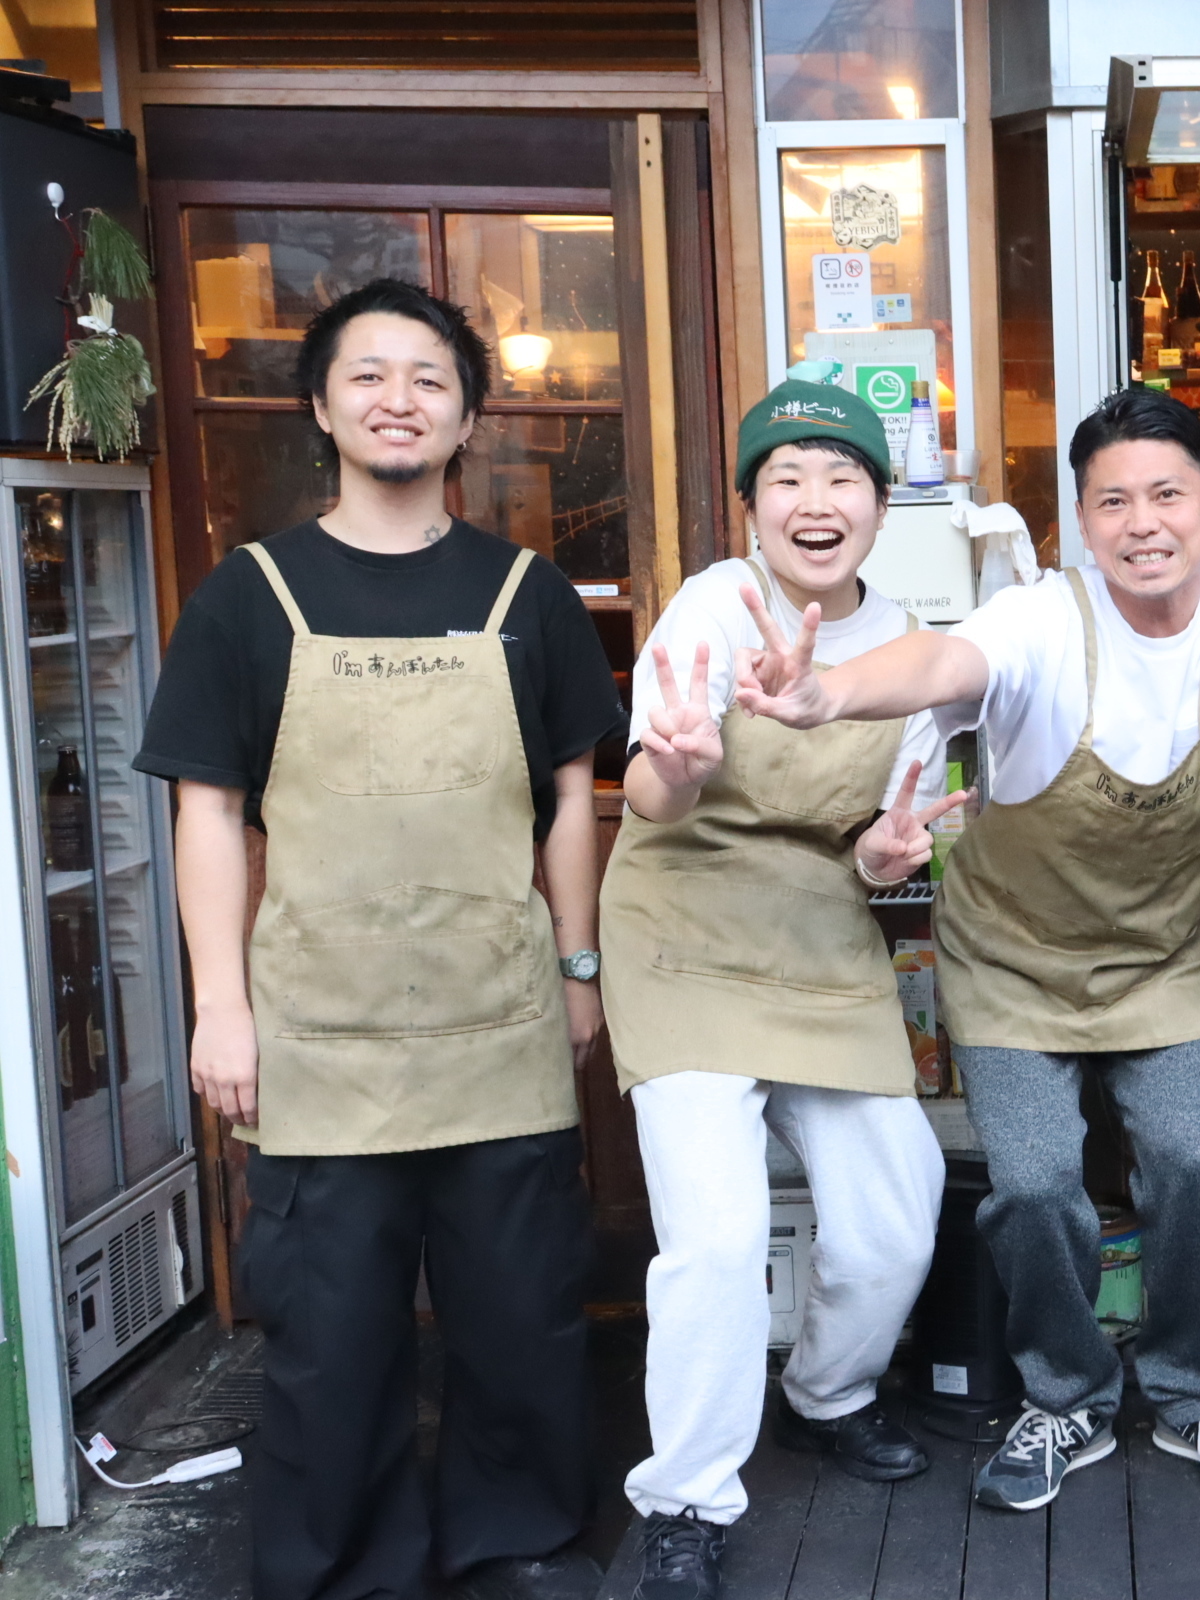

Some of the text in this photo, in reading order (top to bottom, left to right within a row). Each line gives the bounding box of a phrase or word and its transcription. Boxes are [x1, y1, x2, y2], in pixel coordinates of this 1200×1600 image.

[848, 225, 884, 236] YEBISU
[770, 400, 846, 419] 小樽ビール
[915, 597, 951, 608] WARMER
[333, 650, 465, 678] I'm あんぽんたん
[1096, 773, 1195, 811] I'm あんぽんたん
